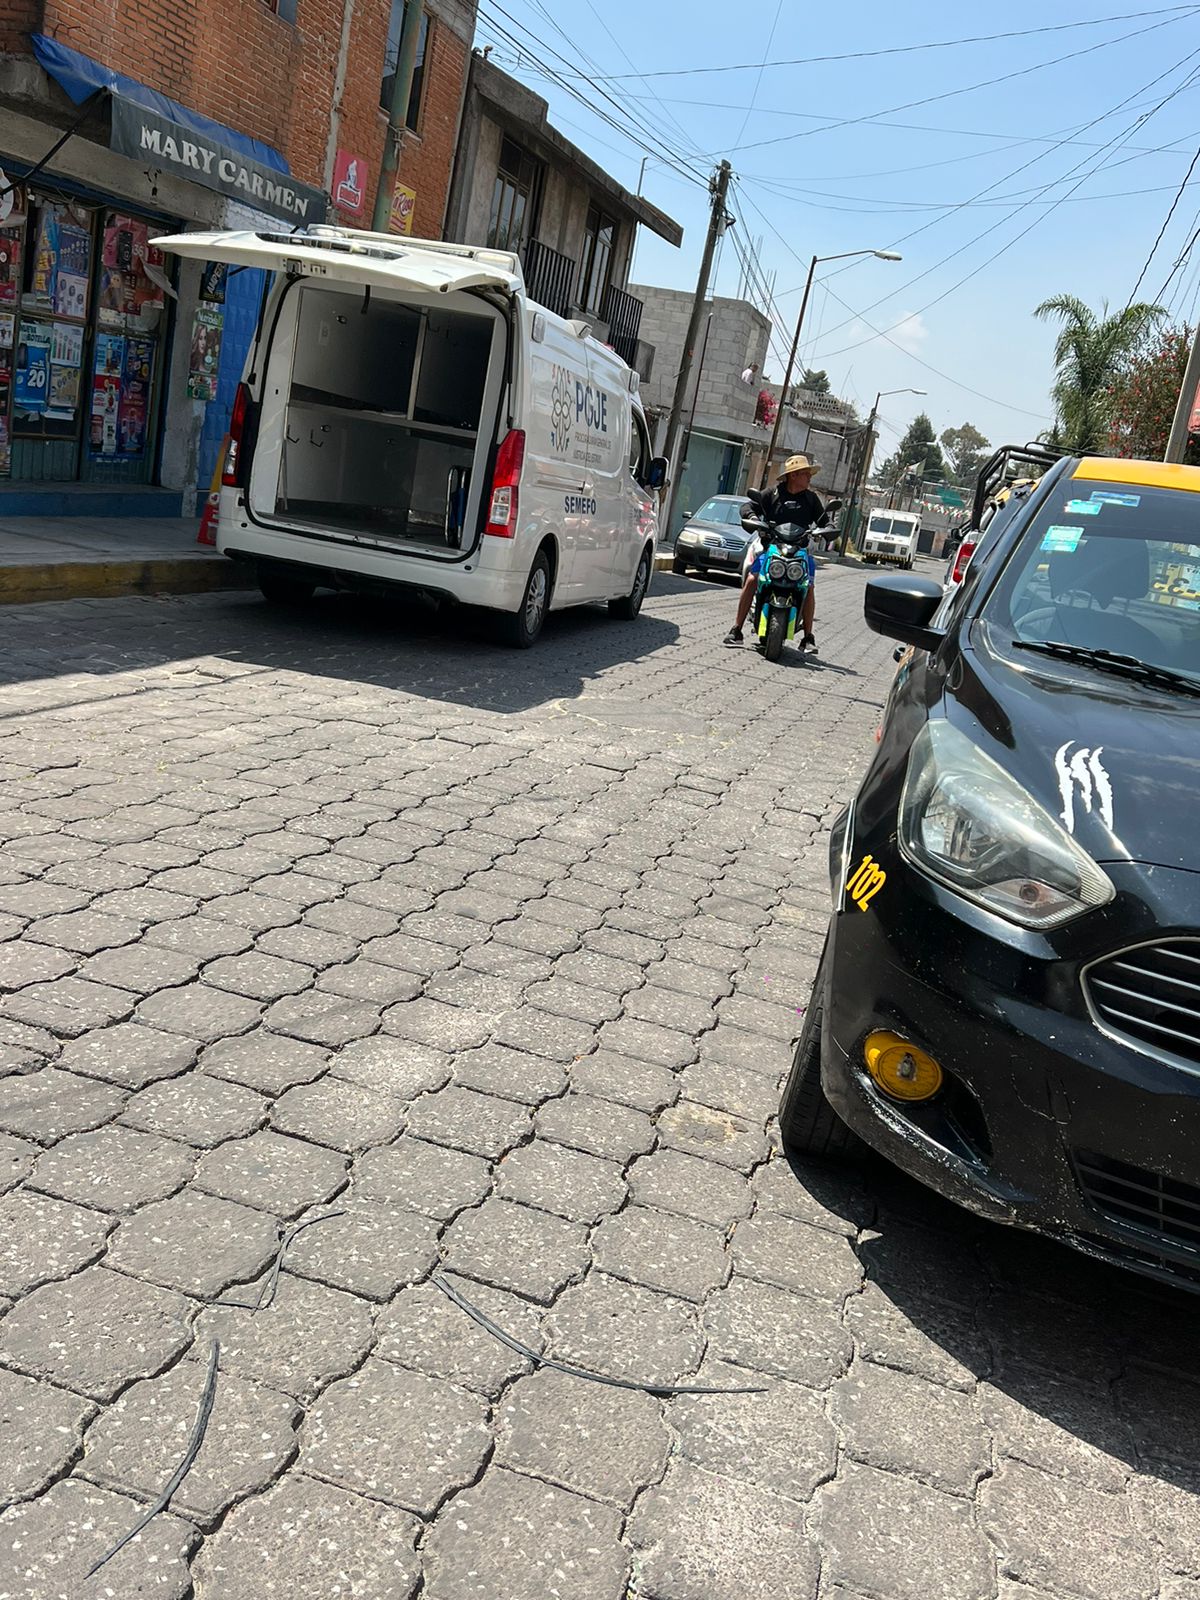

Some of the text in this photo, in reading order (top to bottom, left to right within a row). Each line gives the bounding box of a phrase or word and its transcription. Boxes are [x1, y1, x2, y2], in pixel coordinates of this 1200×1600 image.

[140, 125, 309, 216] MARY CARMEN
[27, 369, 45, 388] 20
[575, 381, 607, 432] PGJE
[564, 496, 597, 516] SEMEFO
[846, 854, 886, 912] 102
